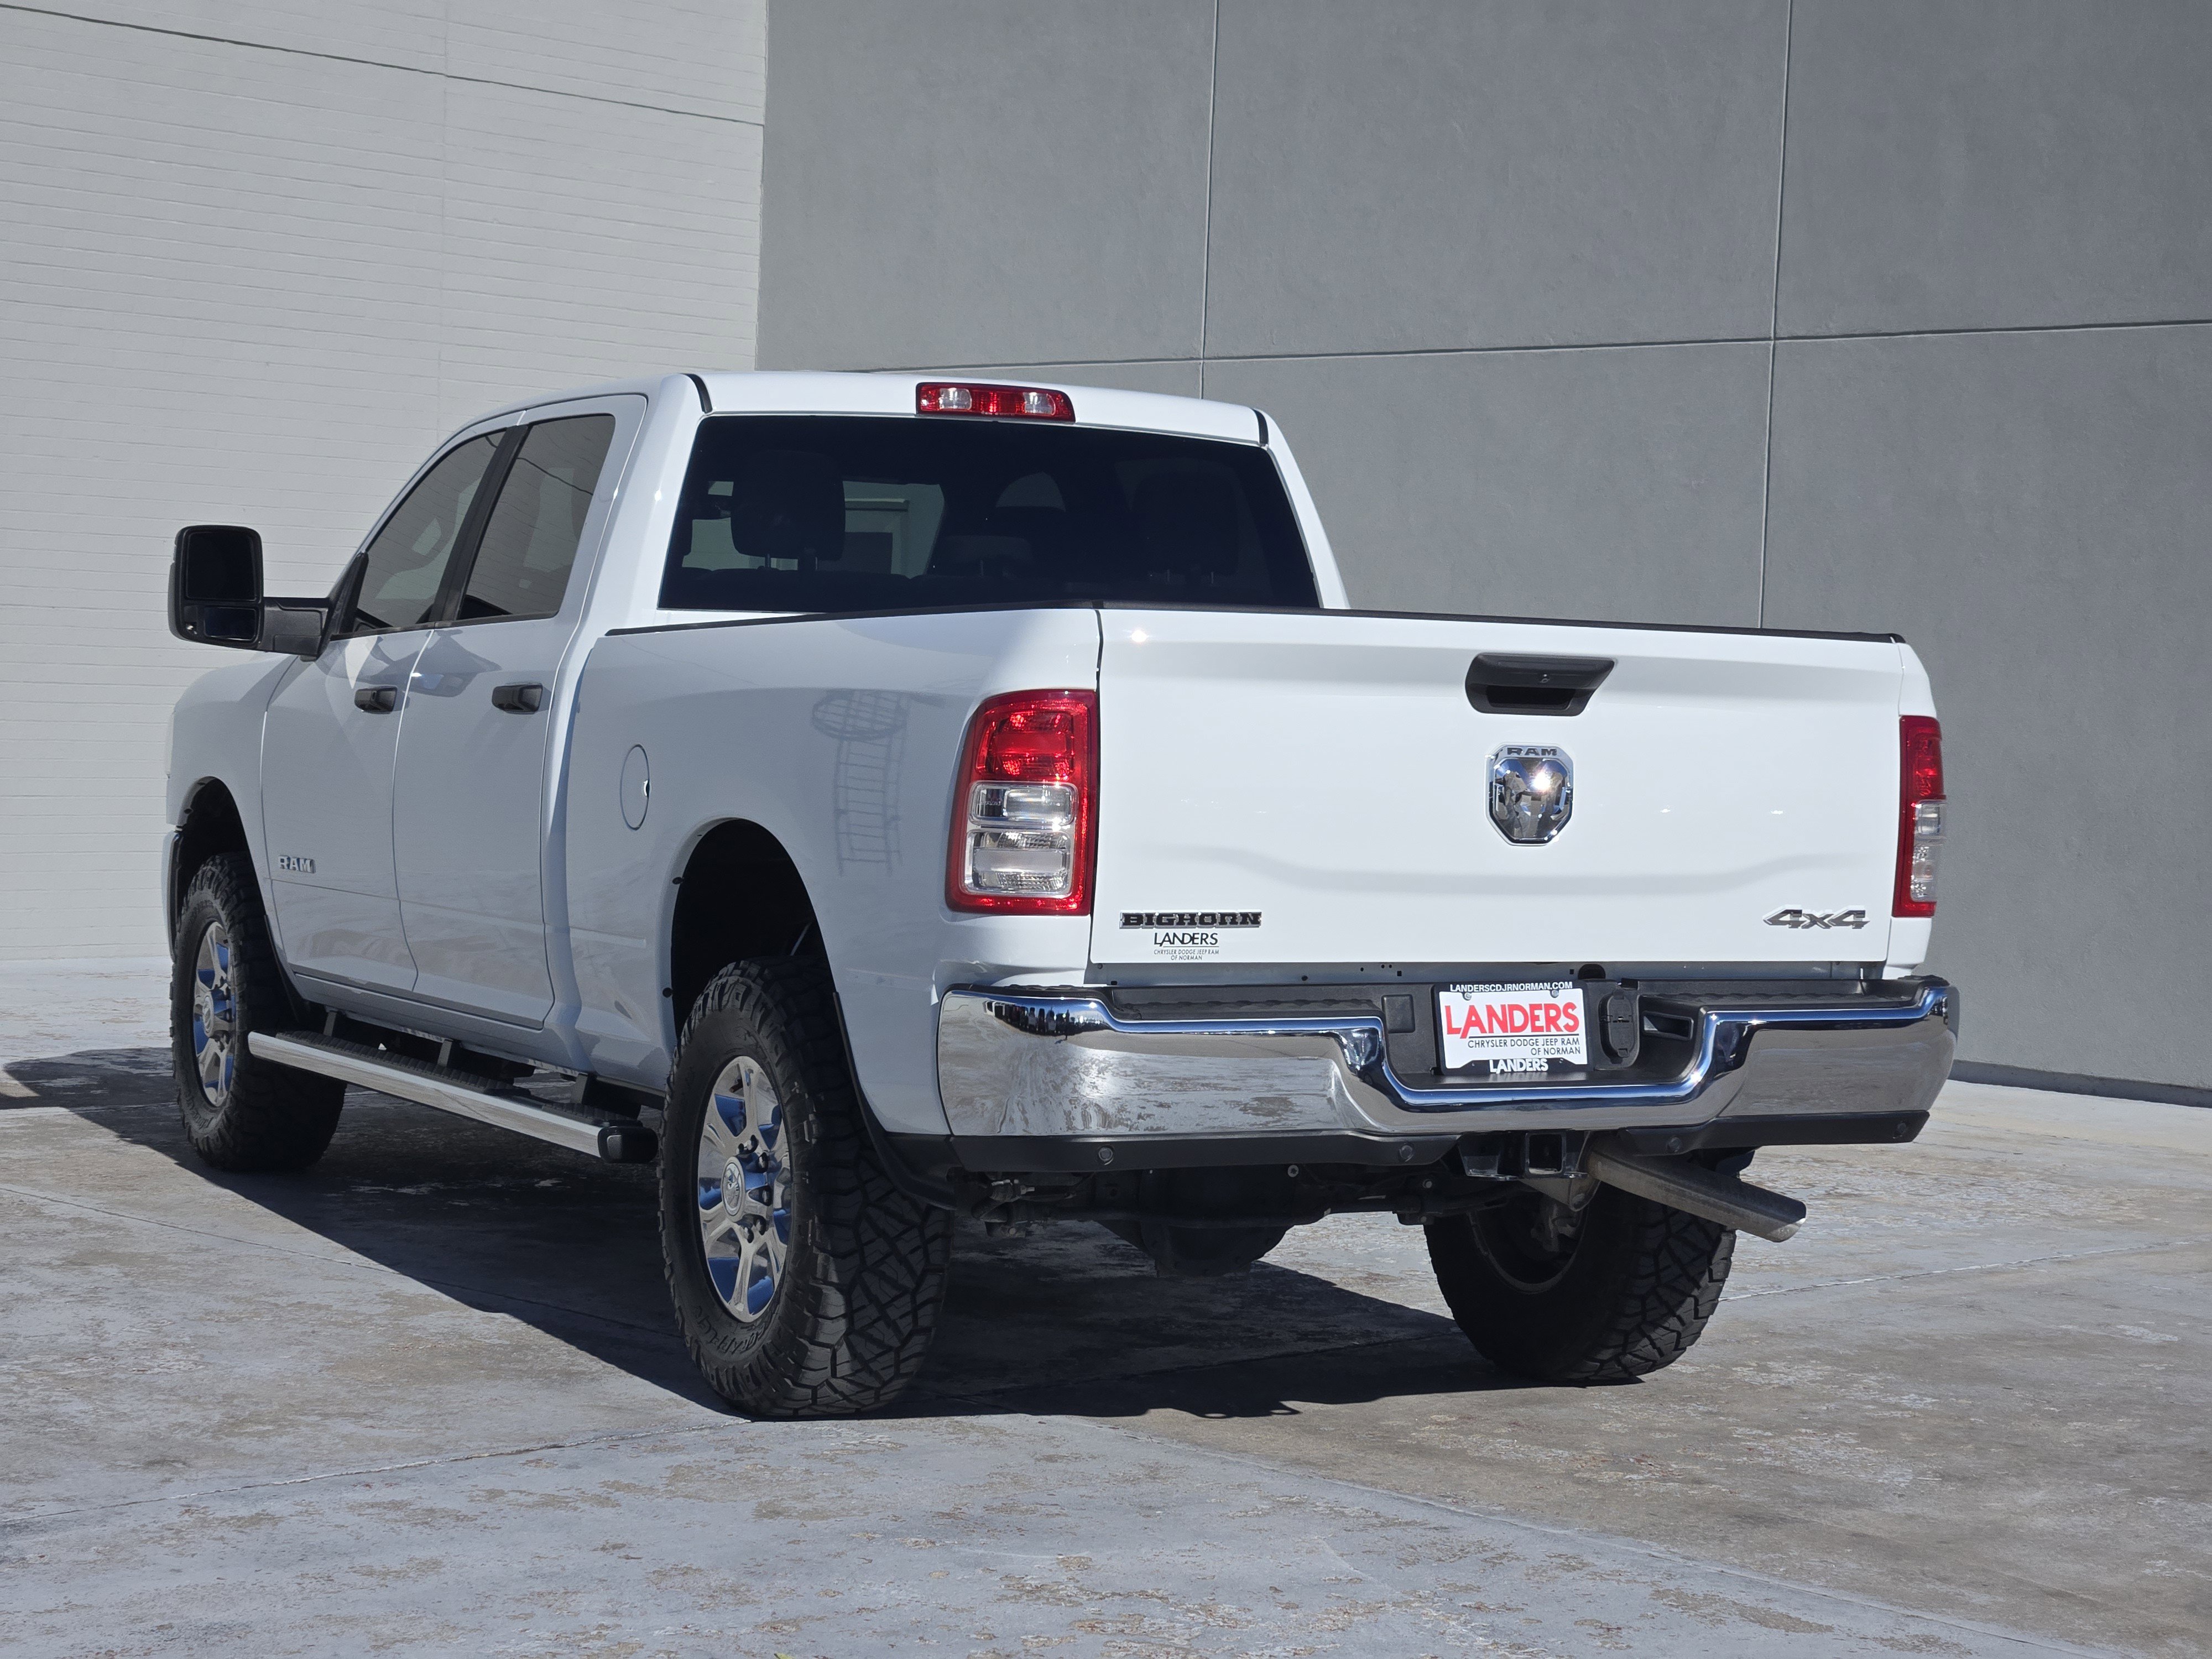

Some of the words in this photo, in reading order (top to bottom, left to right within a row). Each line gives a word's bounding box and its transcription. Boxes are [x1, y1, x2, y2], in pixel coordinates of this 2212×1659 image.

[1507, 747, 1557, 756] RAM
[278, 855, 315, 873] RAM
[1119, 911, 1262, 929] BIGHORN
[1154, 932, 1218, 947] LANDERS
[1449, 981, 1573, 993] LANDERSCDJRNORMAN.COM
[1444, 1001, 1580, 1039] LANDERS
[1467, 1039, 1507, 1048] CHRYSLER
[1510, 1038, 1540, 1047] DODGE
[1541, 1038, 1558, 1046] JEEP
[1561, 1037, 1580, 1046] RAM
[1543, 1046, 1580, 1055] NORMAN
[1489, 1057, 1549, 1074] LANDERS
